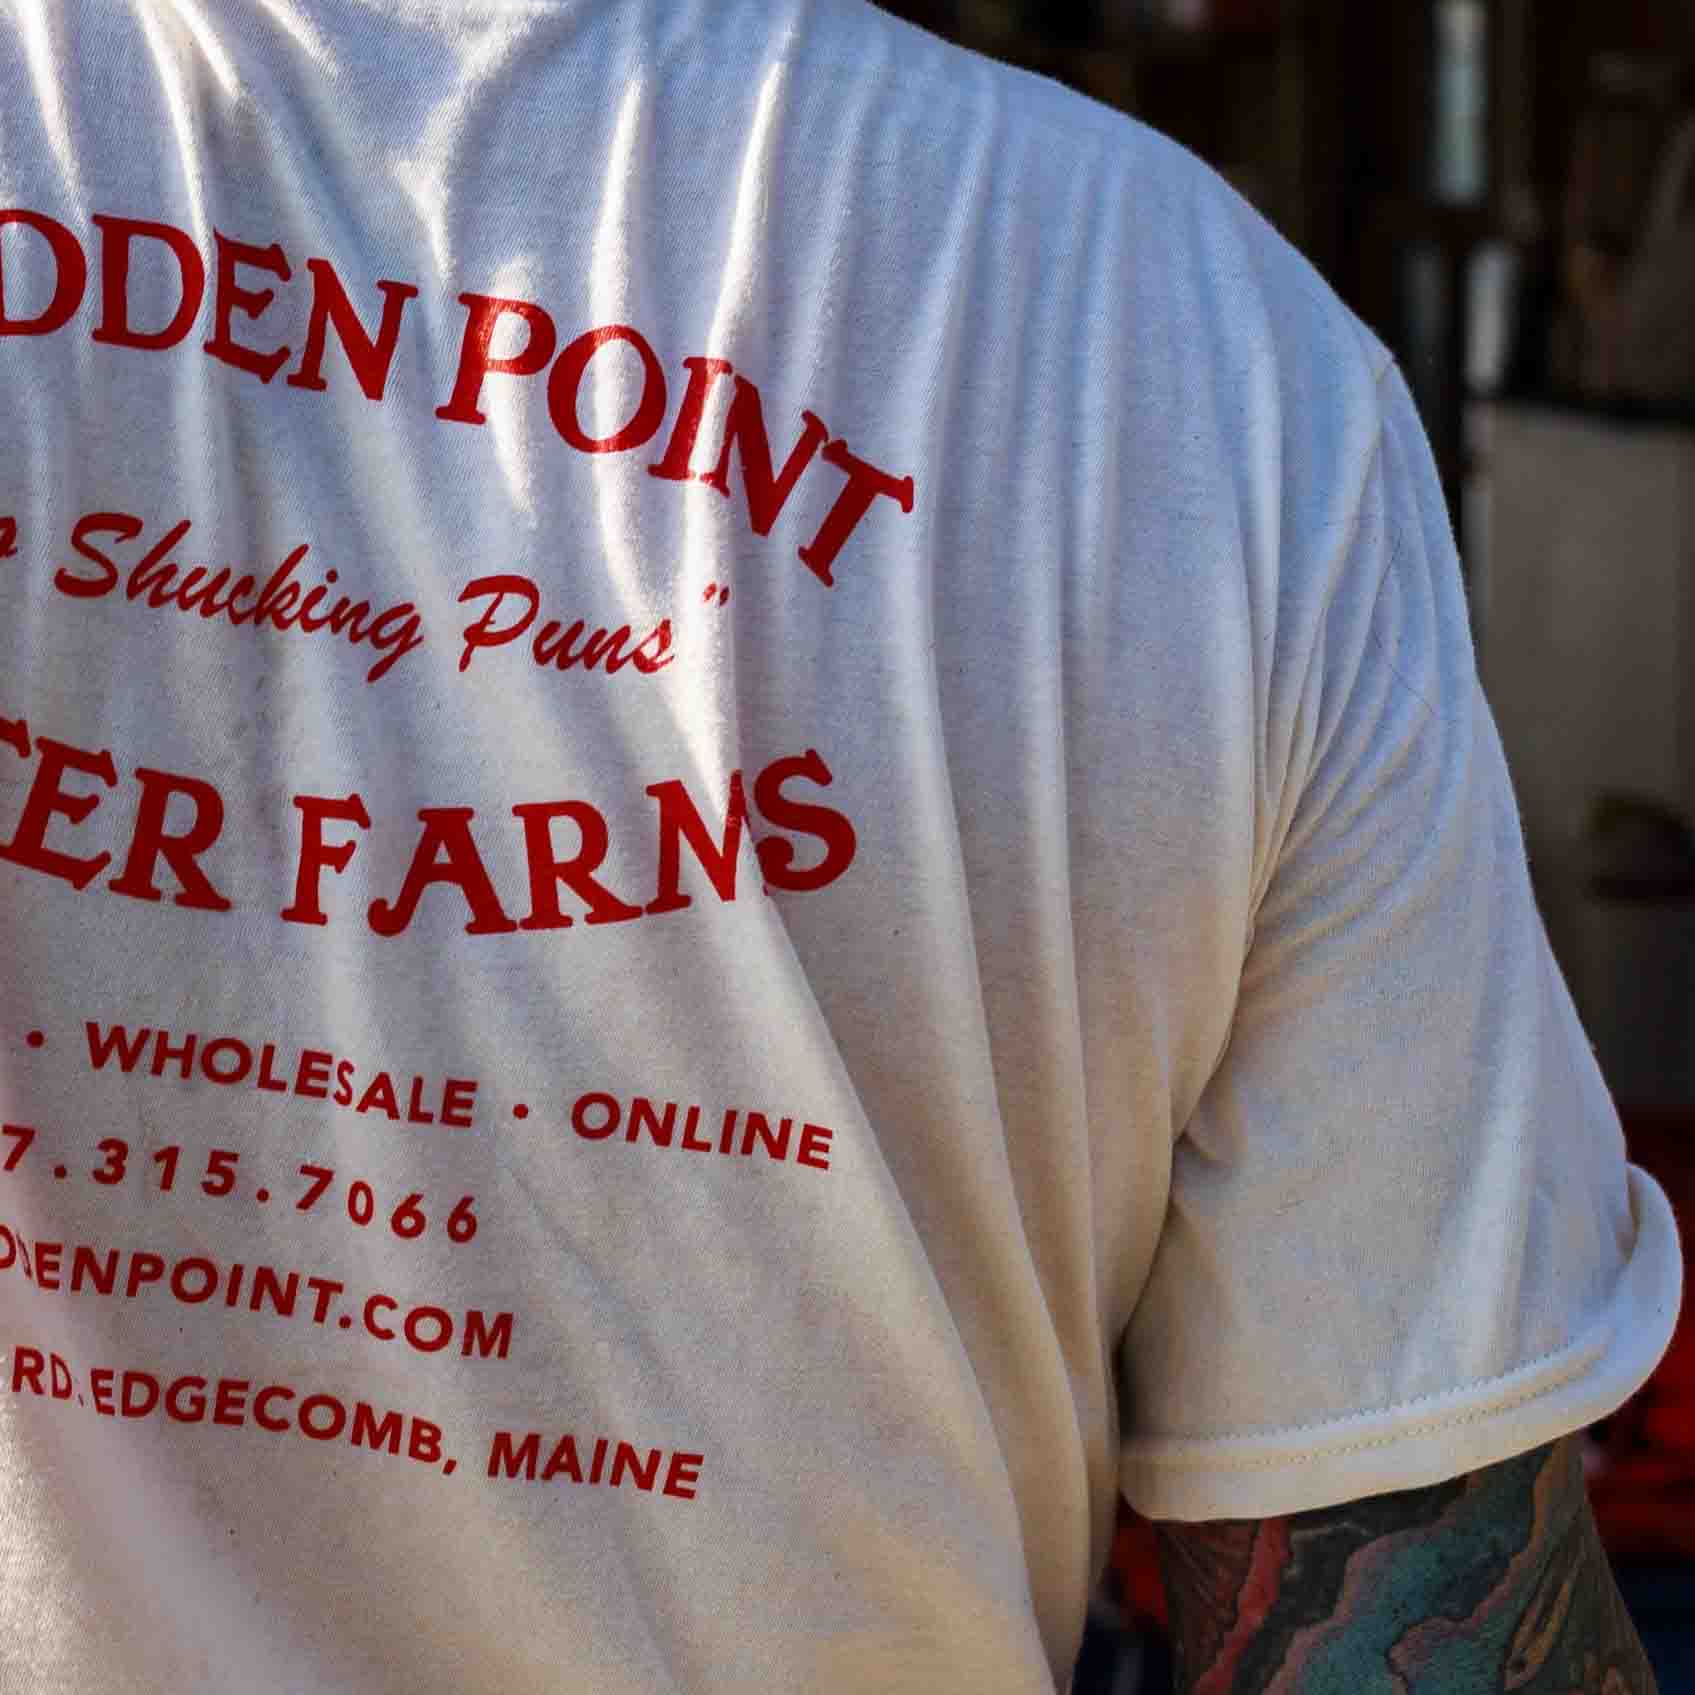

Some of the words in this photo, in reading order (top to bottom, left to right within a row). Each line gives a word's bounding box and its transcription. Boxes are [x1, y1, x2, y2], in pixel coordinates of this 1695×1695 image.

[435, 292, 915, 587] POINT
[54, 511, 422, 683] Shucking
[86, 1023, 479, 1129] WHOLESALE
[571, 1092, 834, 1171] ONLINE
[486, 1431, 706, 1501] MAINE
